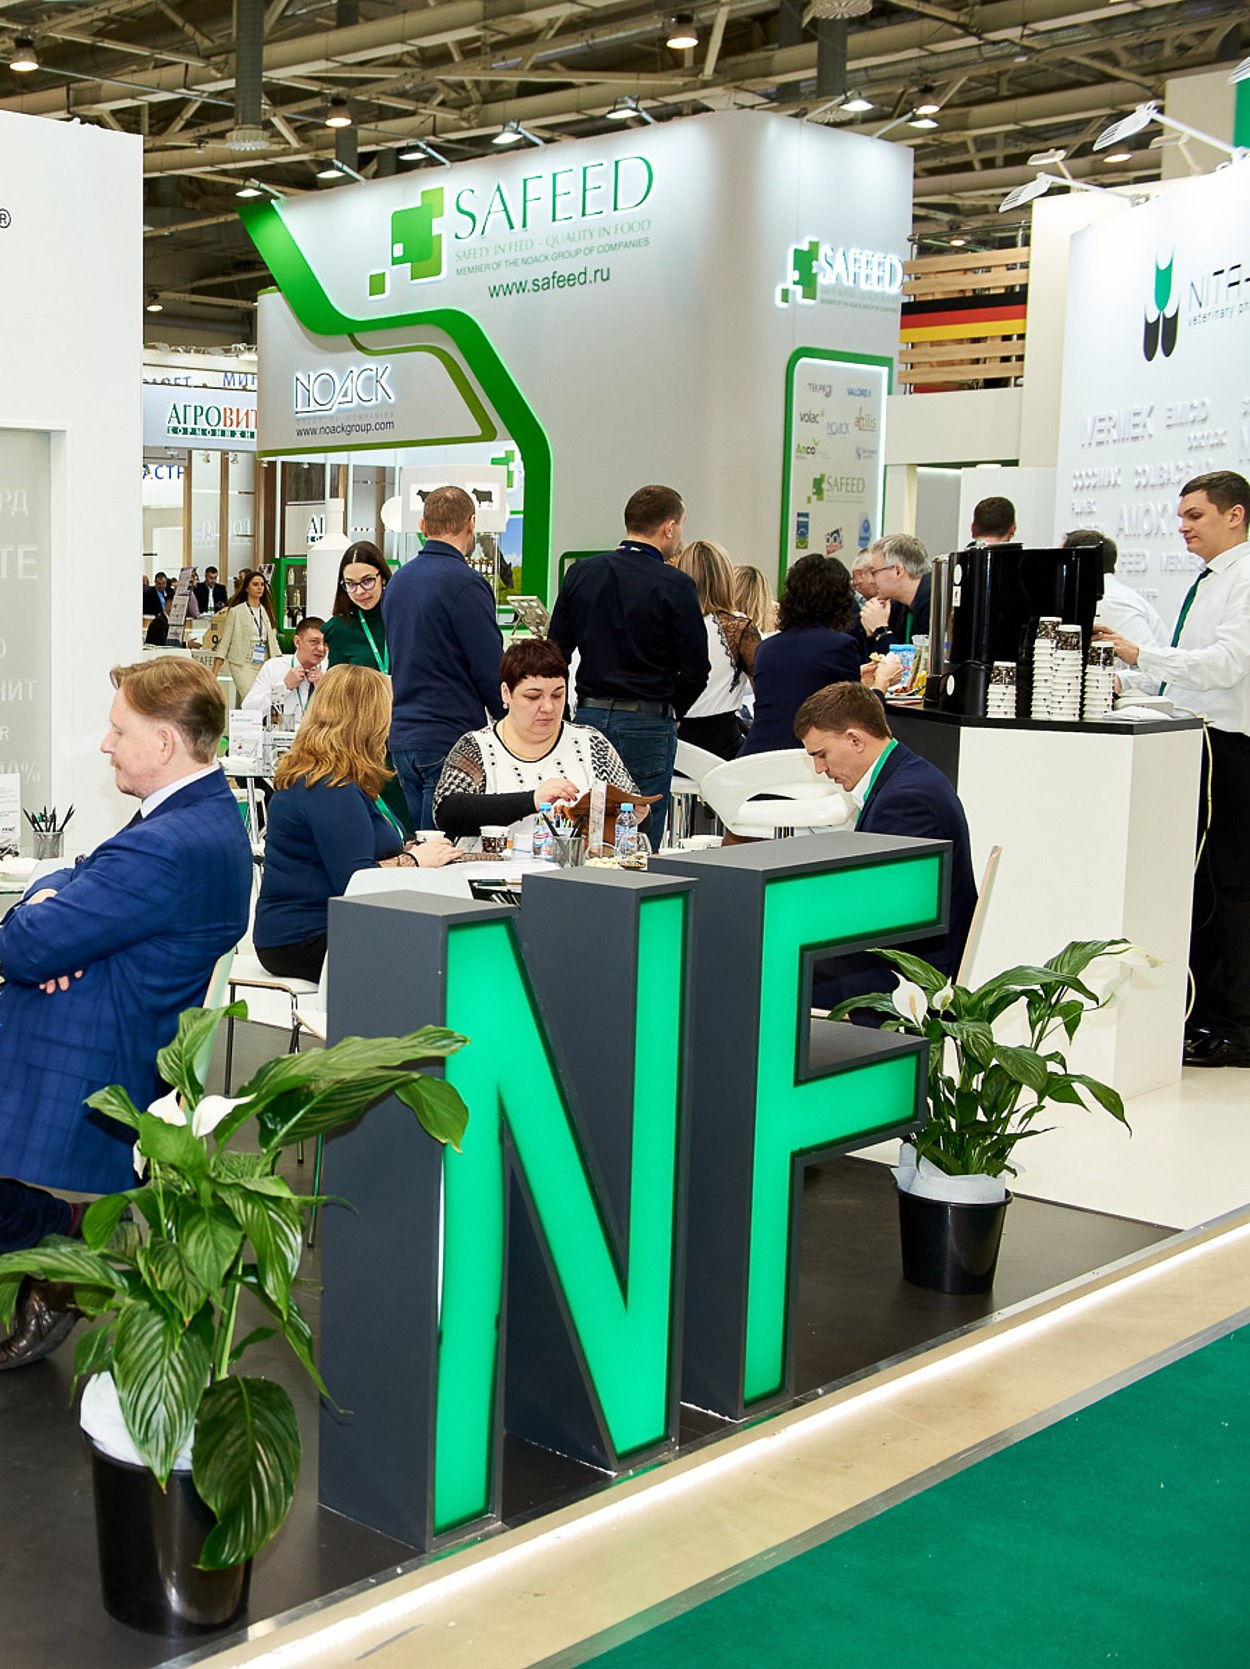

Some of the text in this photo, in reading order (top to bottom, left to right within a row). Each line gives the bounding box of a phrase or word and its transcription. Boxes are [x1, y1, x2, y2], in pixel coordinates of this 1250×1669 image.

[454, 156, 654, 240] SAFEED
[455, 246, 491, 263] SAFETY
[493, 244, 506, 256] IN
[508, 239, 534, 254] FEED
[545, 228, 595, 248] QUALITY
[598, 226, 611, 238] IN
[614, 218, 651, 236] FOOD
[456, 262, 491, 276] MEMBER
[493, 261, 504, 271] OF
[519, 253, 549, 267] NOACK
[551, 248, 582, 262] GROUP
[597, 237, 650, 254] COMPANIES
[488, 266, 611, 298] www.safeed.ru
[820, 245, 904, 291] SAFEED
[295, 420, 395, 438] www.noackgroup.com
[826, 476, 866, 494] SAFEED
